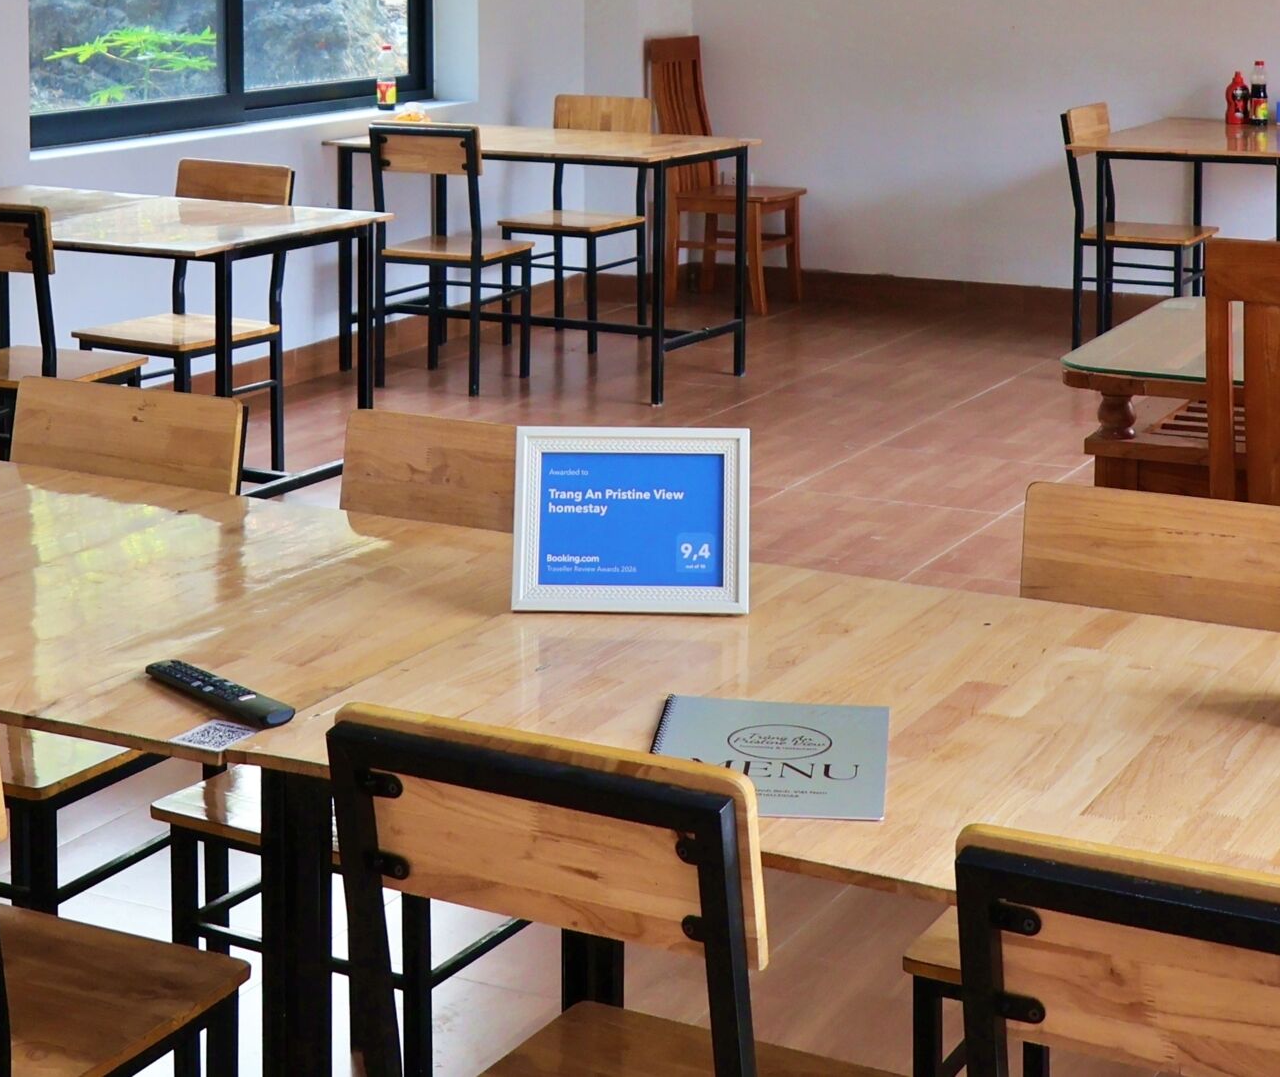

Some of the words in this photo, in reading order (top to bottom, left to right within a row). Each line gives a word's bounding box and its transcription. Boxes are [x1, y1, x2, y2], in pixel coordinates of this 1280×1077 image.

[548, 468, 580, 476] Awarded
[581, 468, 589, 476] to
[548, 488, 582, 502] Trang
[585, 488, 602, 500] An
[605, 488, 651, 500] Pristine
[653, 489, 685, 500] View
[548, 502, 608, 516] homestay
[546, 553, 600, 565] Booking.com
[680, 542, 711, 562] 9,4
